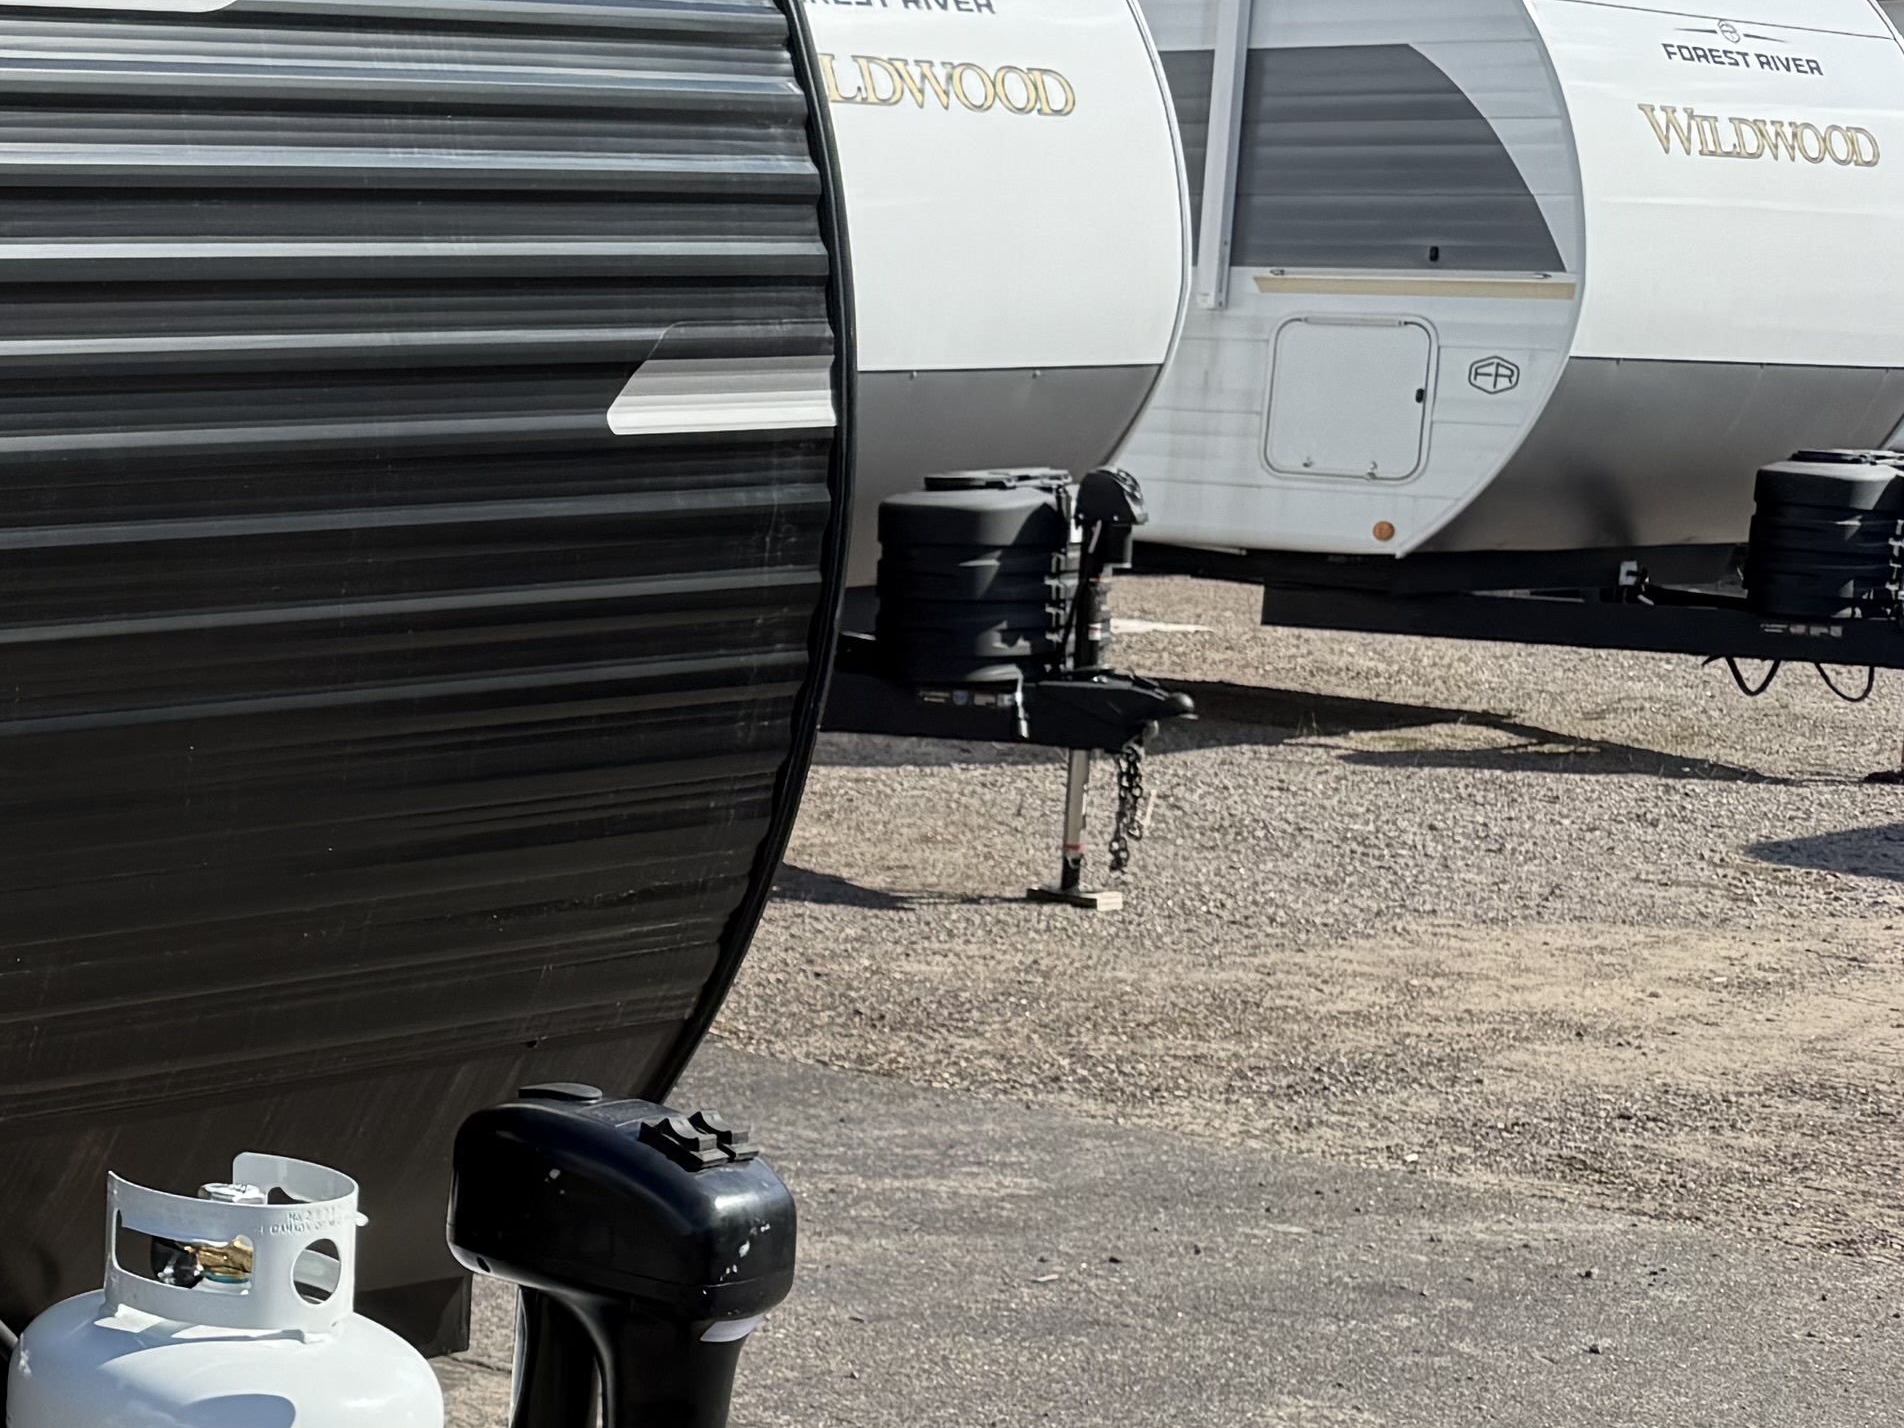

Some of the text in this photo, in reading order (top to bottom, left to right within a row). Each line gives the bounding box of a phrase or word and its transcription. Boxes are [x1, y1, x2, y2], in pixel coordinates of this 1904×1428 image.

[818, 52, 1077, 117] LDWOOD
[1661, 42, 1824, 77] FOREST RIVER
